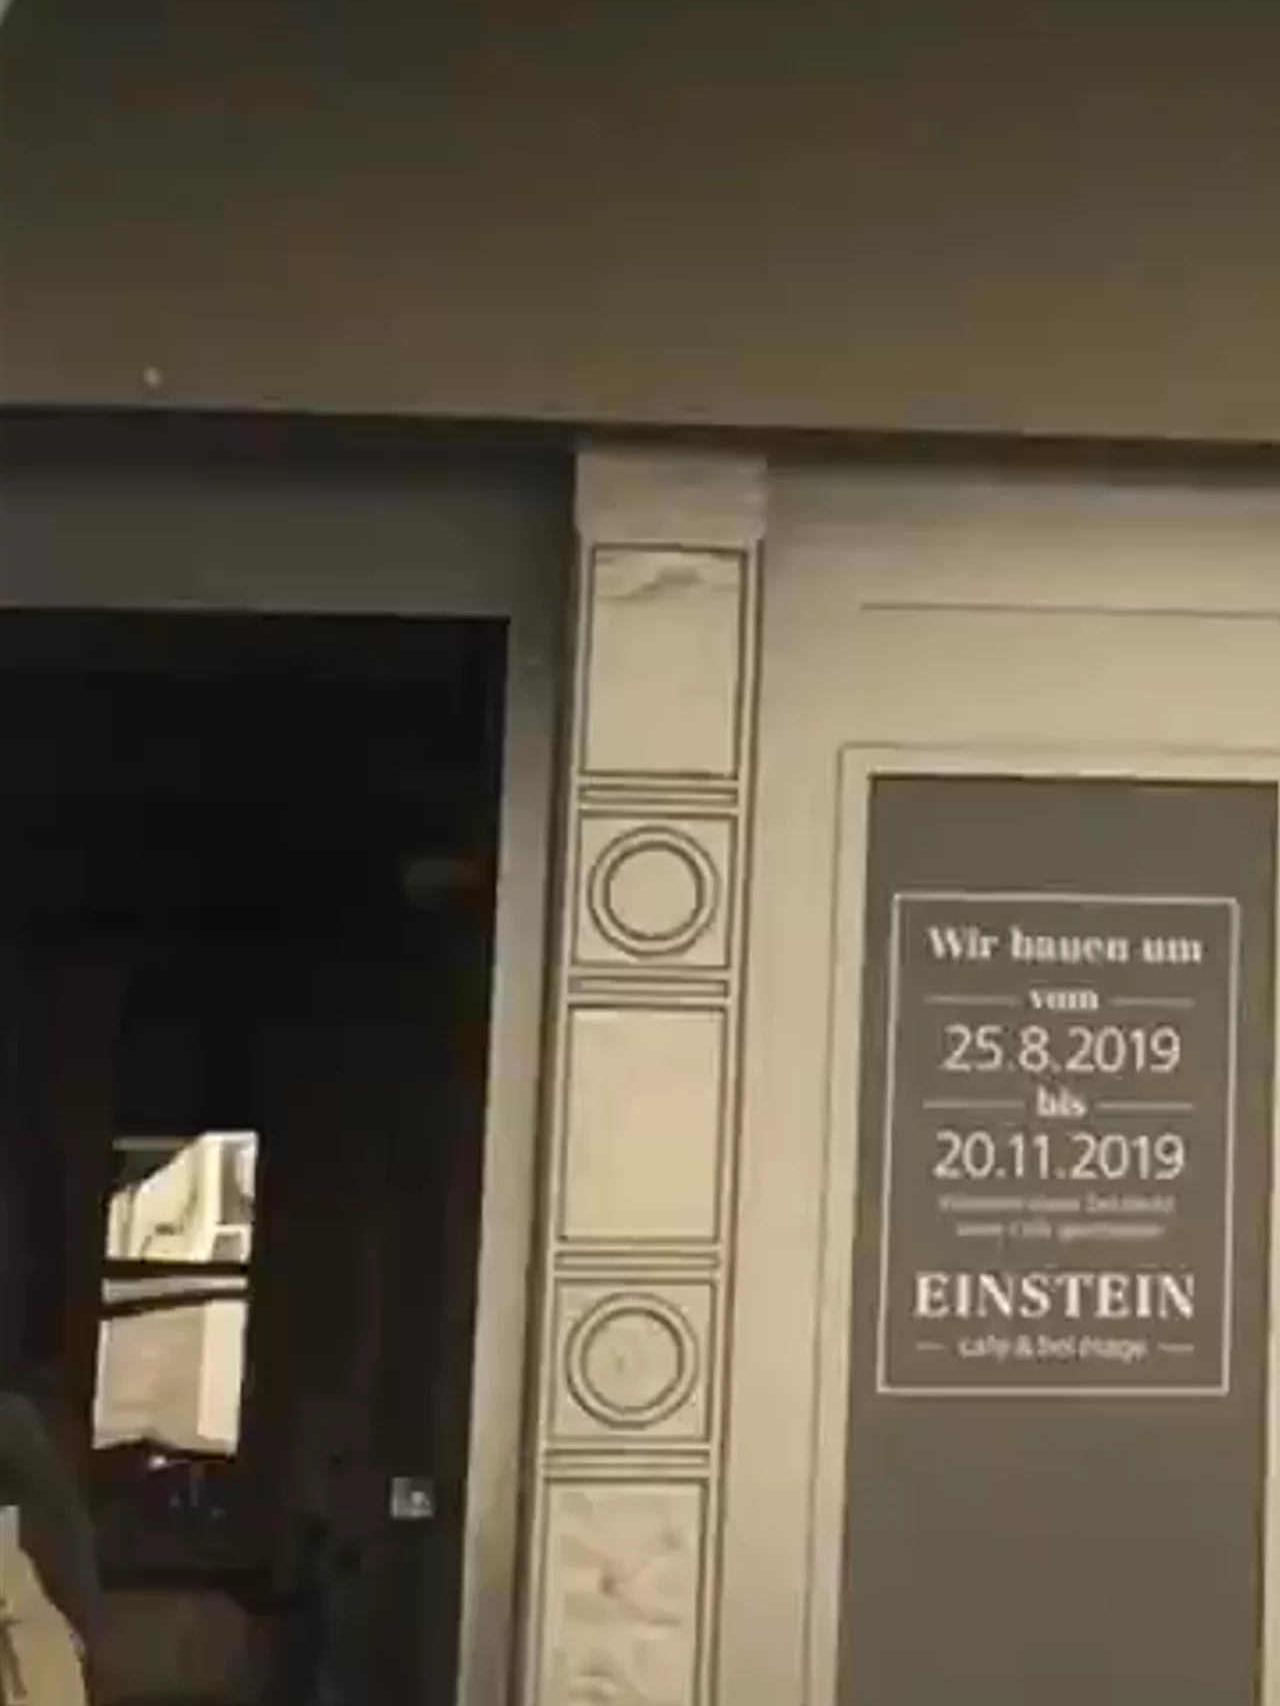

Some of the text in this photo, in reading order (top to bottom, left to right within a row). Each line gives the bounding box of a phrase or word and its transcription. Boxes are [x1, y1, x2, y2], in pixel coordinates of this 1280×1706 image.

[926, 926, 1203, 964] Wir bauen um
[1028, 988, 1100, 1010] vom
[943, 1024, 1181, 1073] 25.8.2019
[1035, 1088, 1087, 1117] bis
[932, 1131, 1186, 1180] 20.11.2019
[913, 1271, 1195, 1319] EINSTEIN
